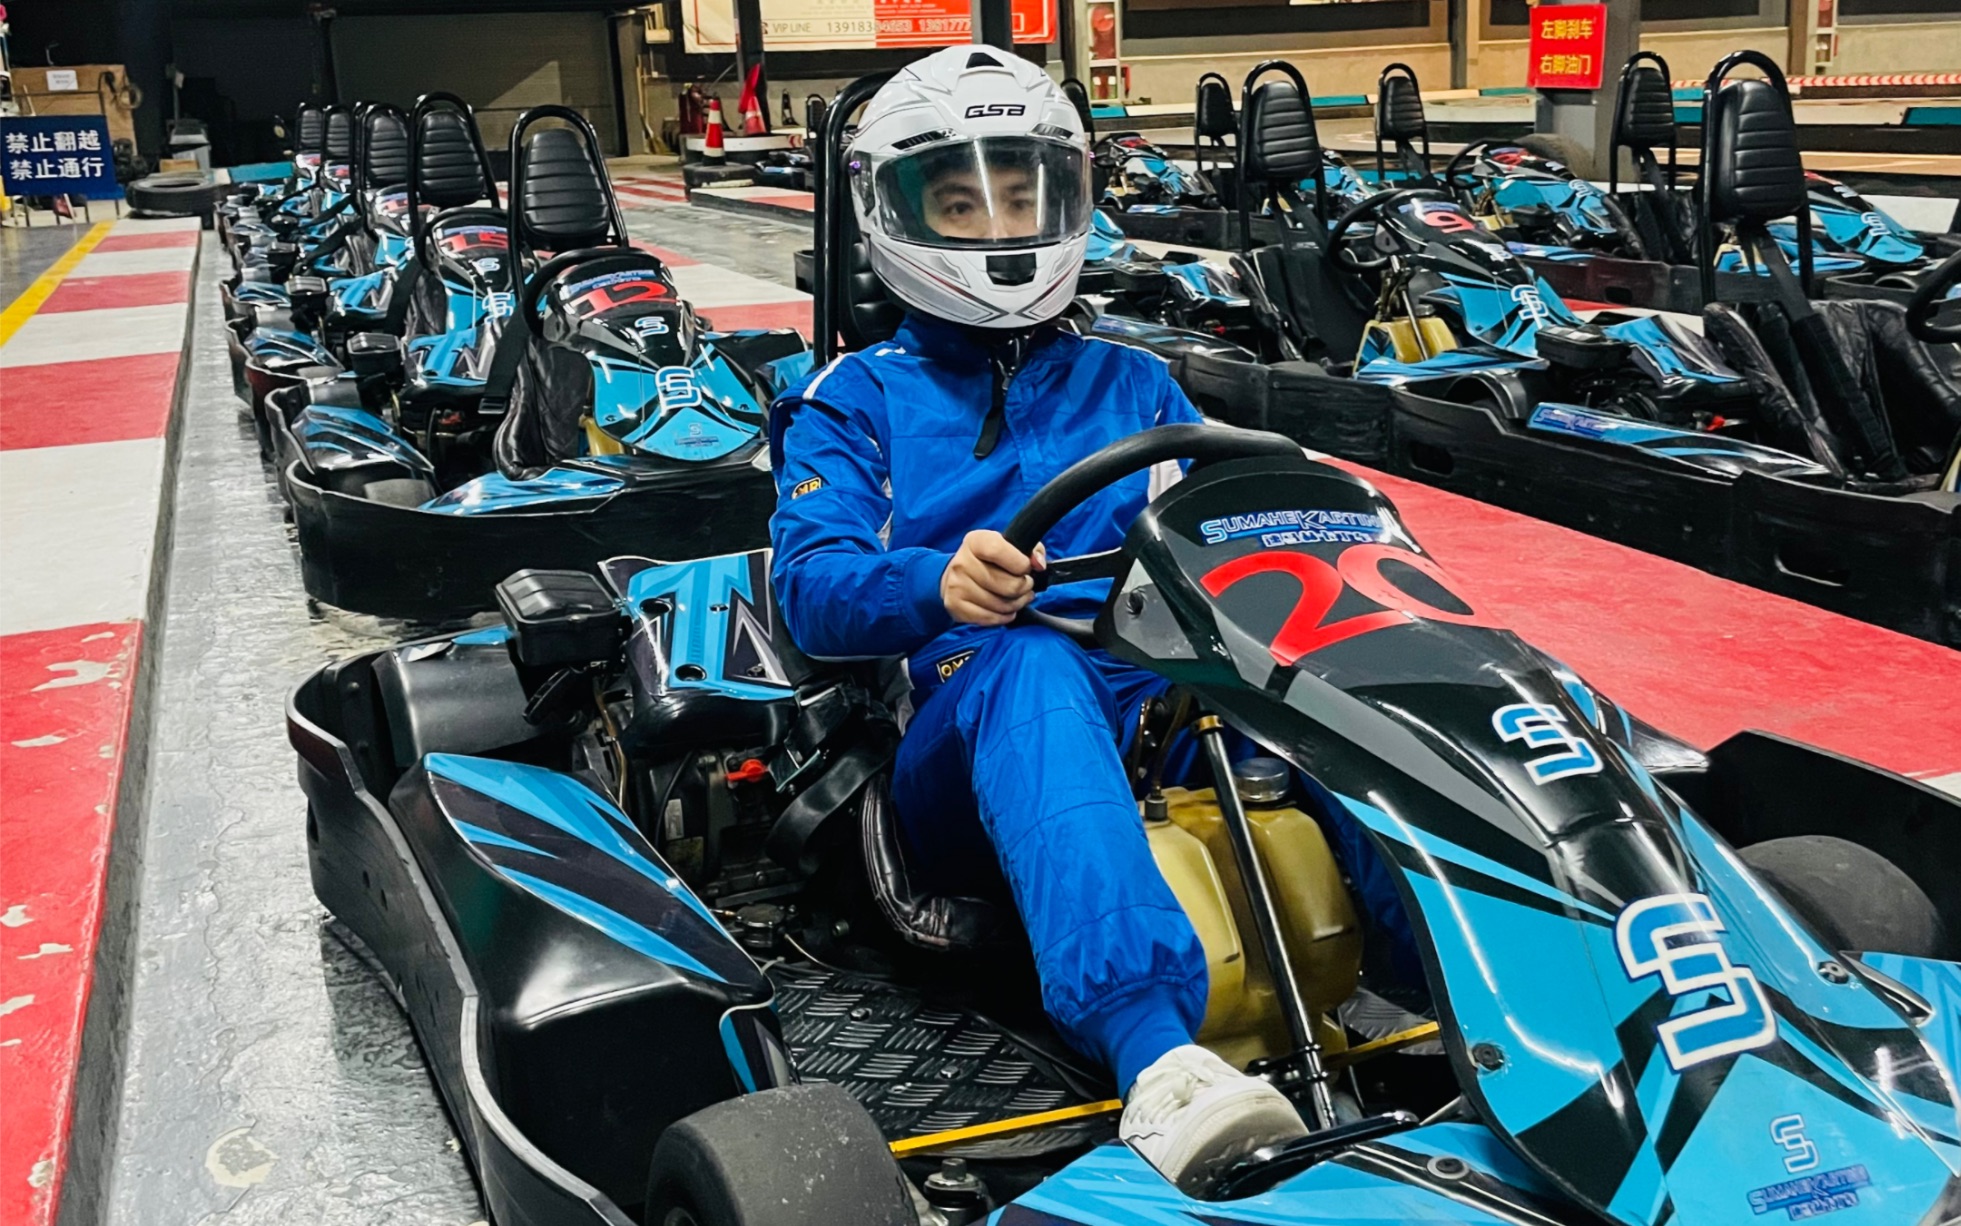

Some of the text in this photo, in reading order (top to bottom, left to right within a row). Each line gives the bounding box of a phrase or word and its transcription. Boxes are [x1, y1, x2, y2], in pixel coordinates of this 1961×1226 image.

[773, 23, 789, 34] VIP
[790, 22, 812, 33] LINE
[1541, 18, 1593, 39] 左脚刹车
[1540, 54, 1591, 75] 右脚油门
[5, 130, 102, 154] 禁止翻越
[9, 157, 105, 180] 禁止通行
[1200, 543, 1505, 667] 20
[940, 656, 970, 678] OM
